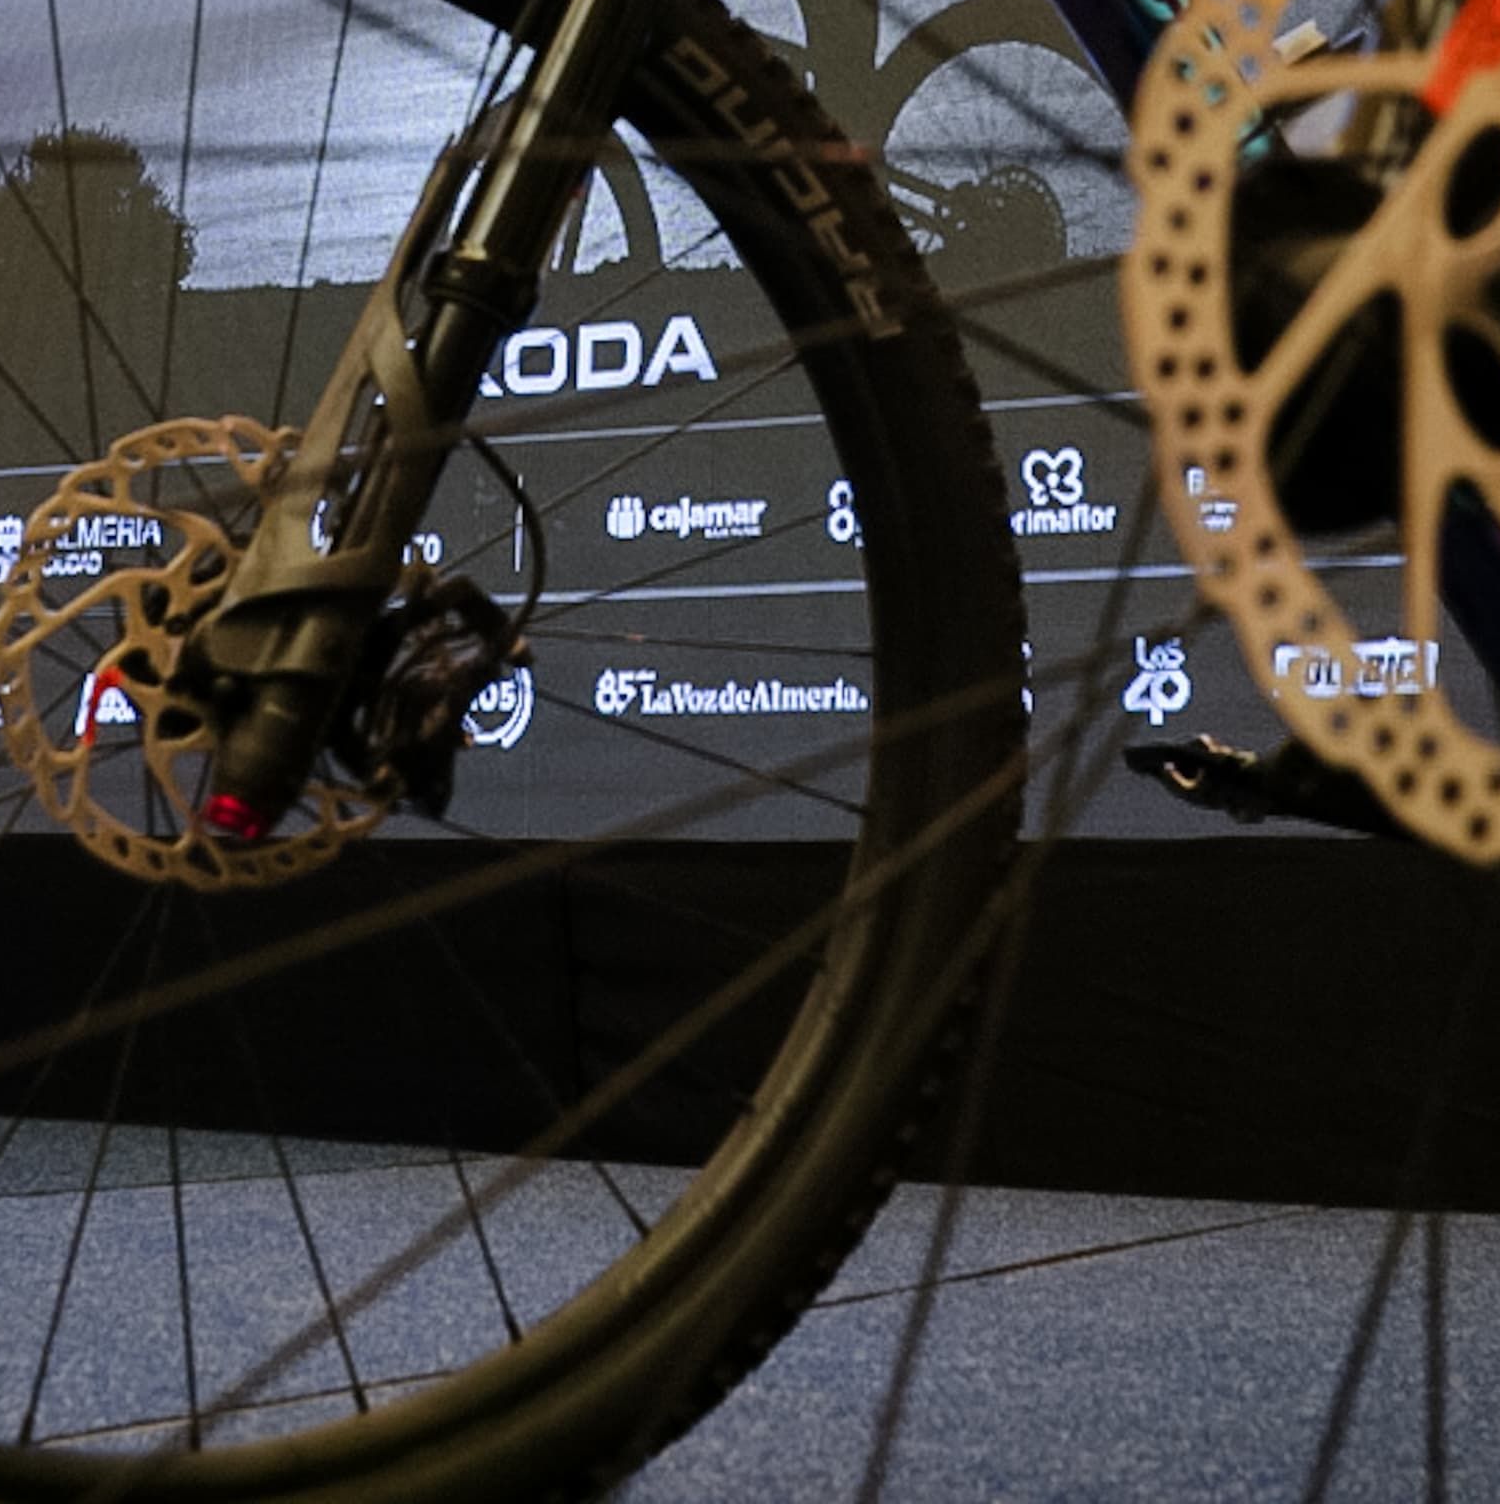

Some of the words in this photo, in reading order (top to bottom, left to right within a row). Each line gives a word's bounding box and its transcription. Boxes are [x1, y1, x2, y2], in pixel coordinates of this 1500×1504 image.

[478, 315, 718, 397] ODA
[650, 497, 767, 539] cajamar
[1124, 670, 1191, 726] 40
